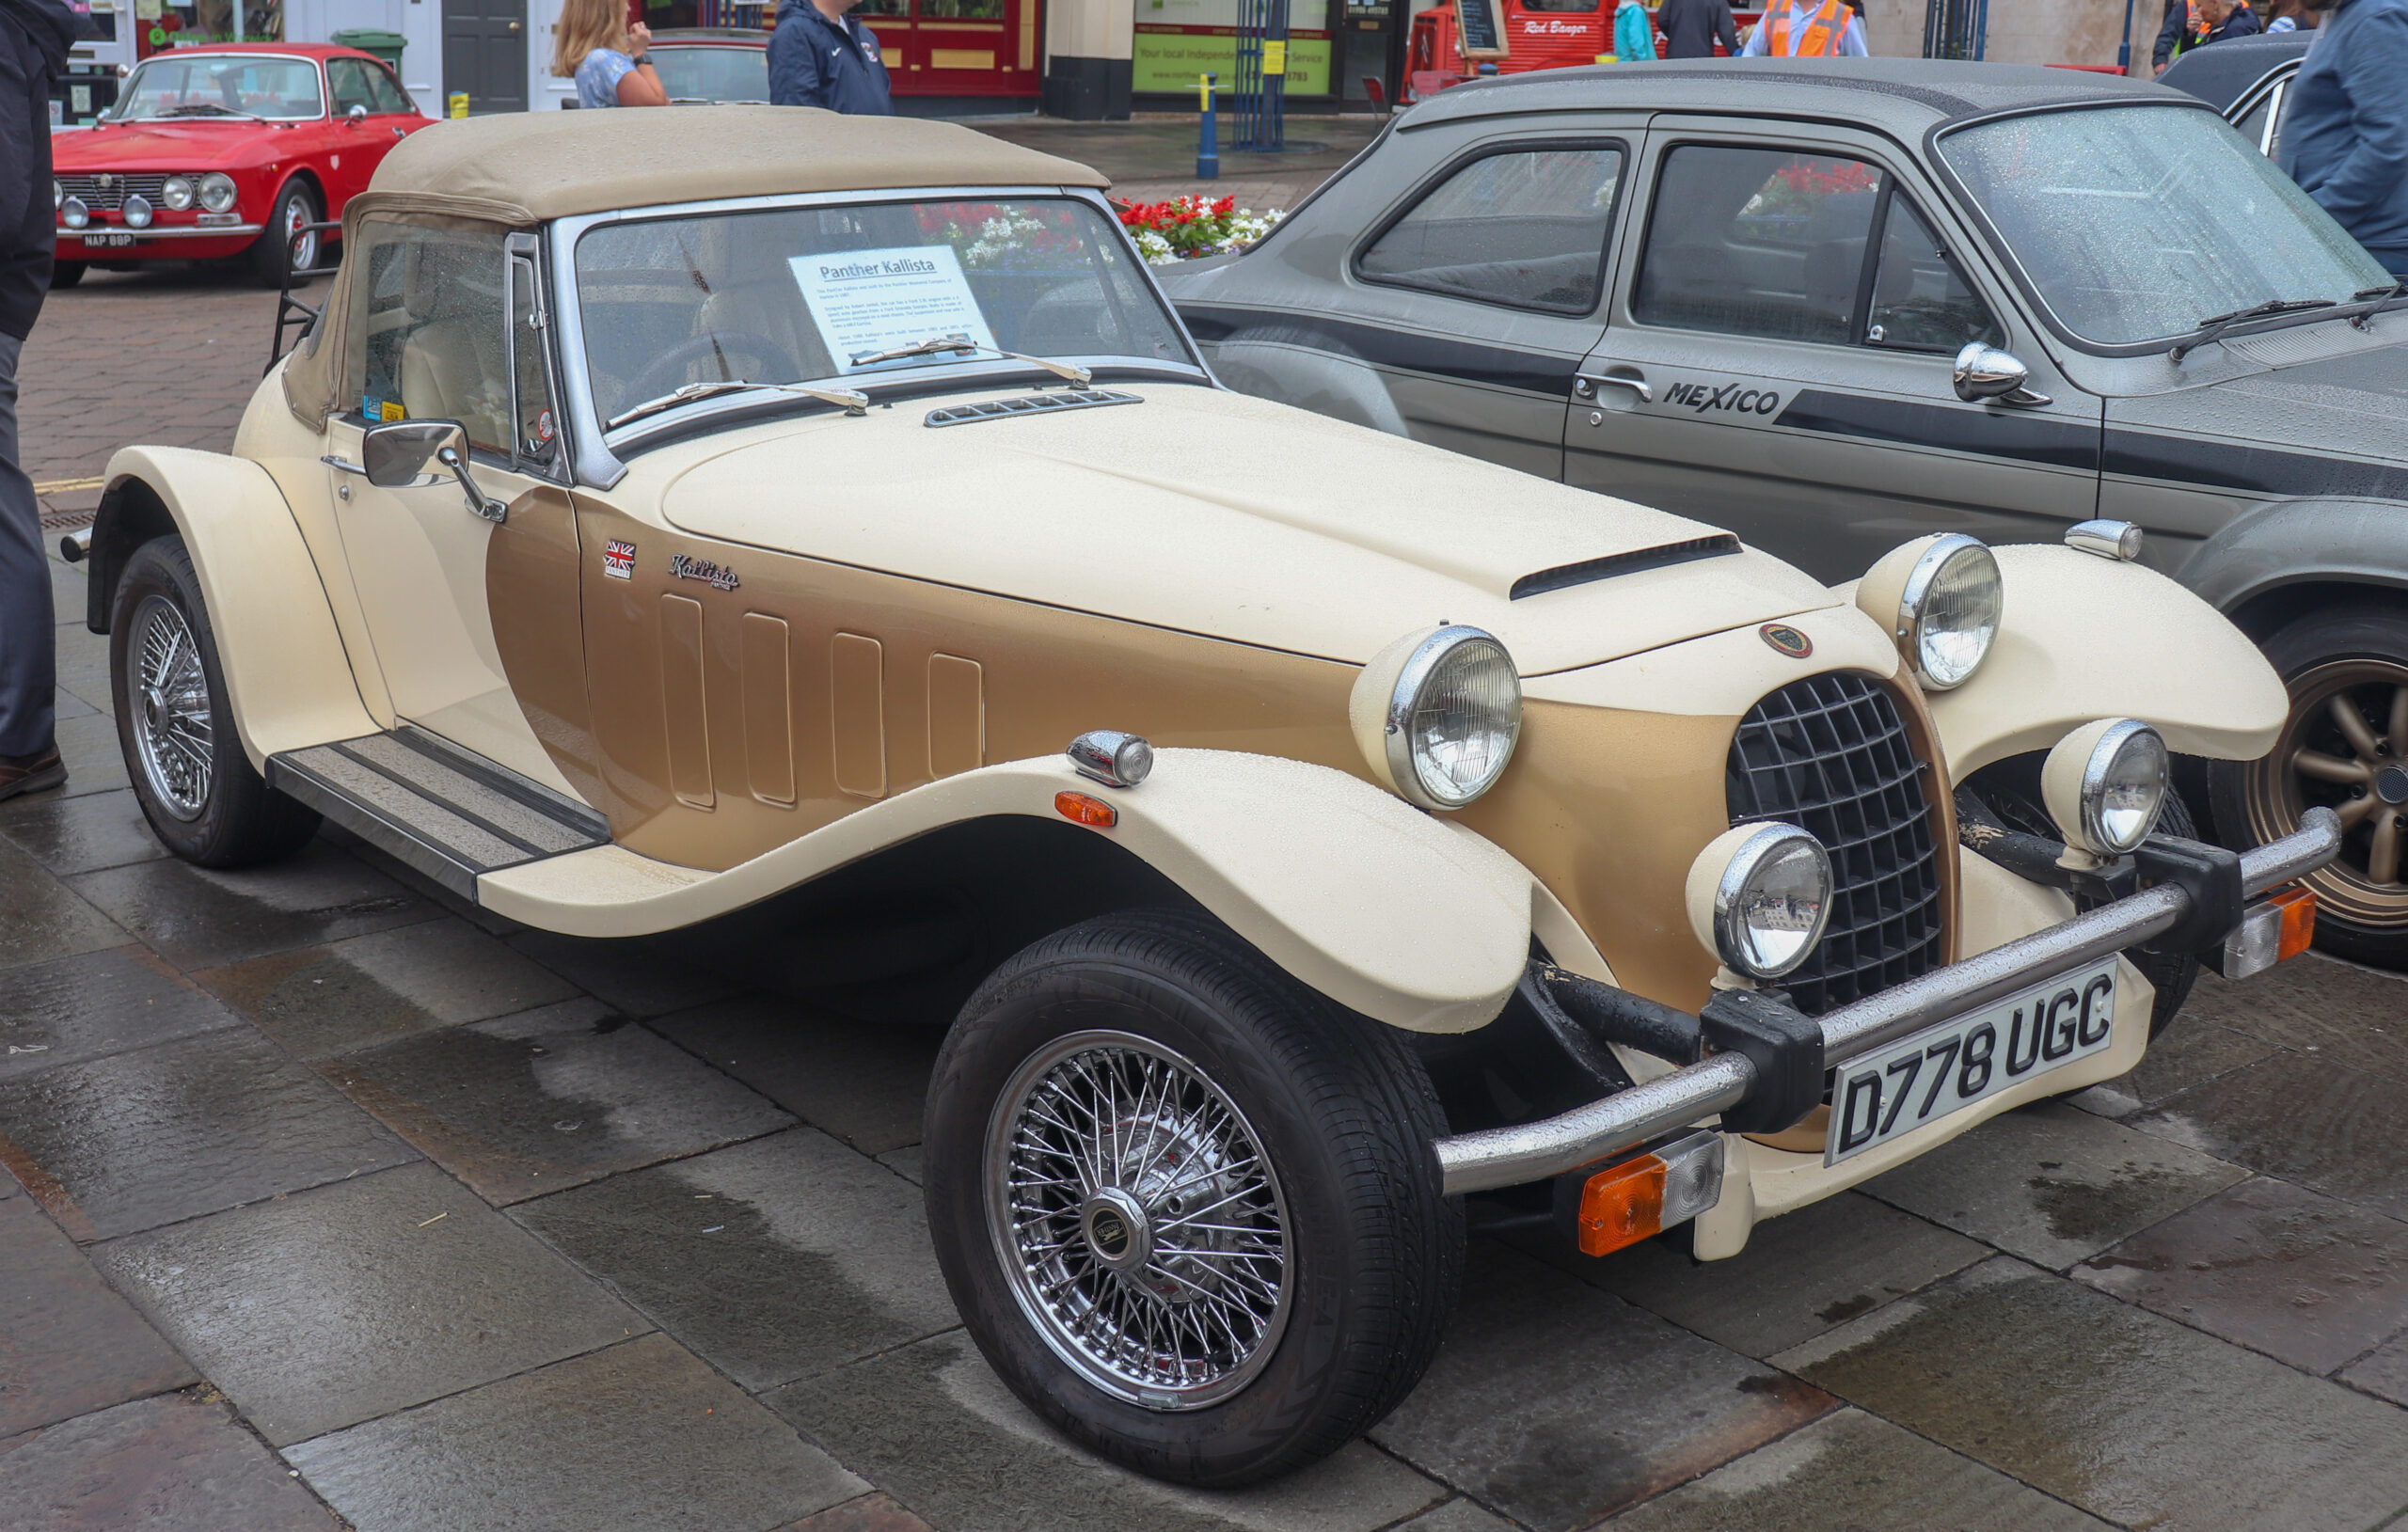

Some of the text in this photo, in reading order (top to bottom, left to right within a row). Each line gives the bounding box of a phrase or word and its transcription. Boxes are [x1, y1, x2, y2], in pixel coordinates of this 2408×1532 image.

[1524, 21, 1588, 37] Red Banger
[1140, 49, 1160, 58] Your
[1163, 48, 1184, 58] local
[1291, 53, 1323, 63] Service
[85, 235, 106, 246] NAP
[819, 258, 935, 279] Panther Kallista
[1663, 382, 1780, 415] MEXICO
[670, 554, 739, 586] Kallista
[1838, 973, 2113, 1154] D778 UGC
